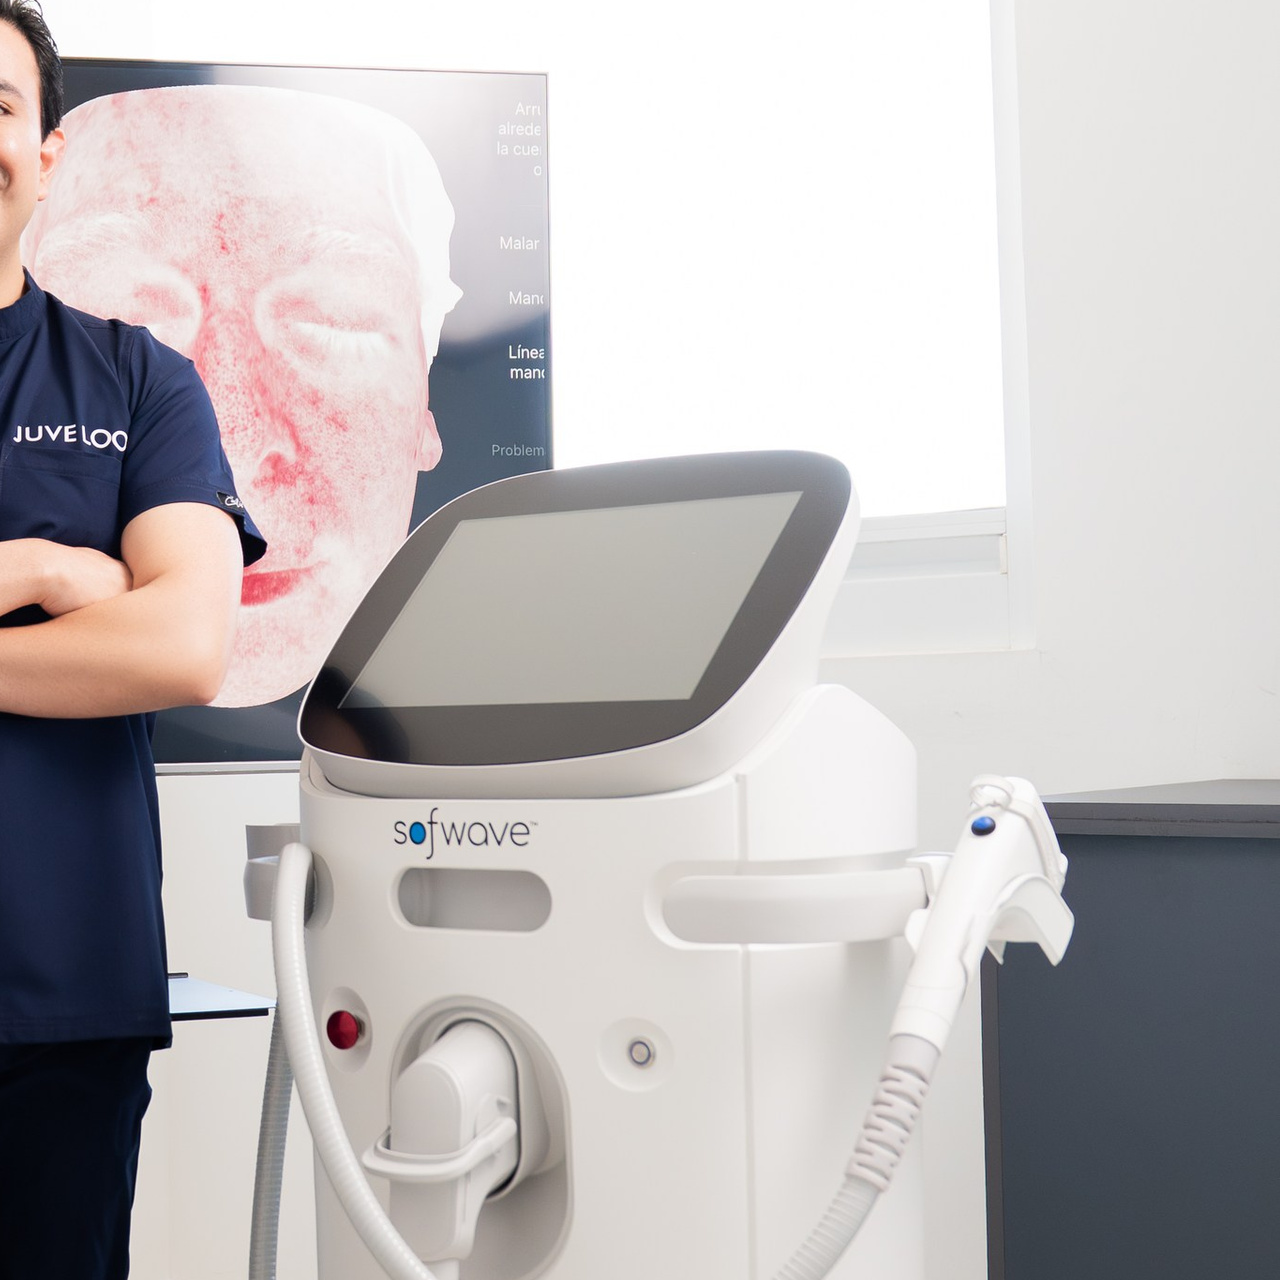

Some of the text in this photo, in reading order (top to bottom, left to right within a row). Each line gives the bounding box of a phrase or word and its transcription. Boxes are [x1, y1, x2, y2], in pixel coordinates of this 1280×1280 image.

[498, 121, 542, 136] alrede
[496, 141, 542, 156] la cue
[500, 236, 540, 250] Malar
[491, 444, 545, 457] Problem
